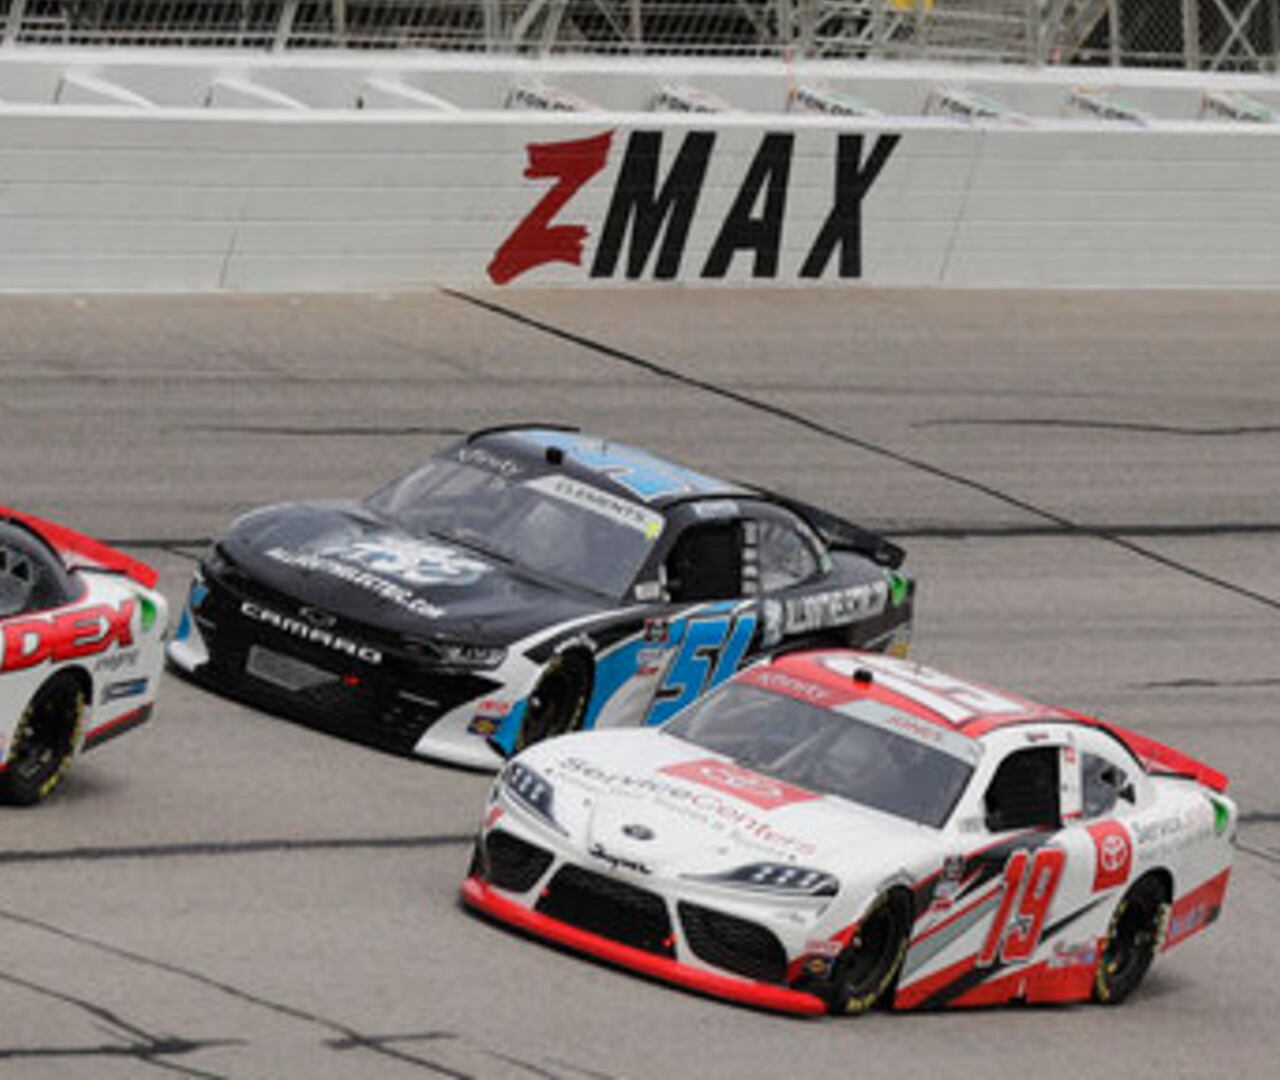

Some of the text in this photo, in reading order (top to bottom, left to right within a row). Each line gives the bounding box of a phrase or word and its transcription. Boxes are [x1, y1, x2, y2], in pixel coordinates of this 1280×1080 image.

[240, 601, 383, 665] CAMARO
[644, 612, 760, 726] 51
[974, 846, 1068, 969] 19
